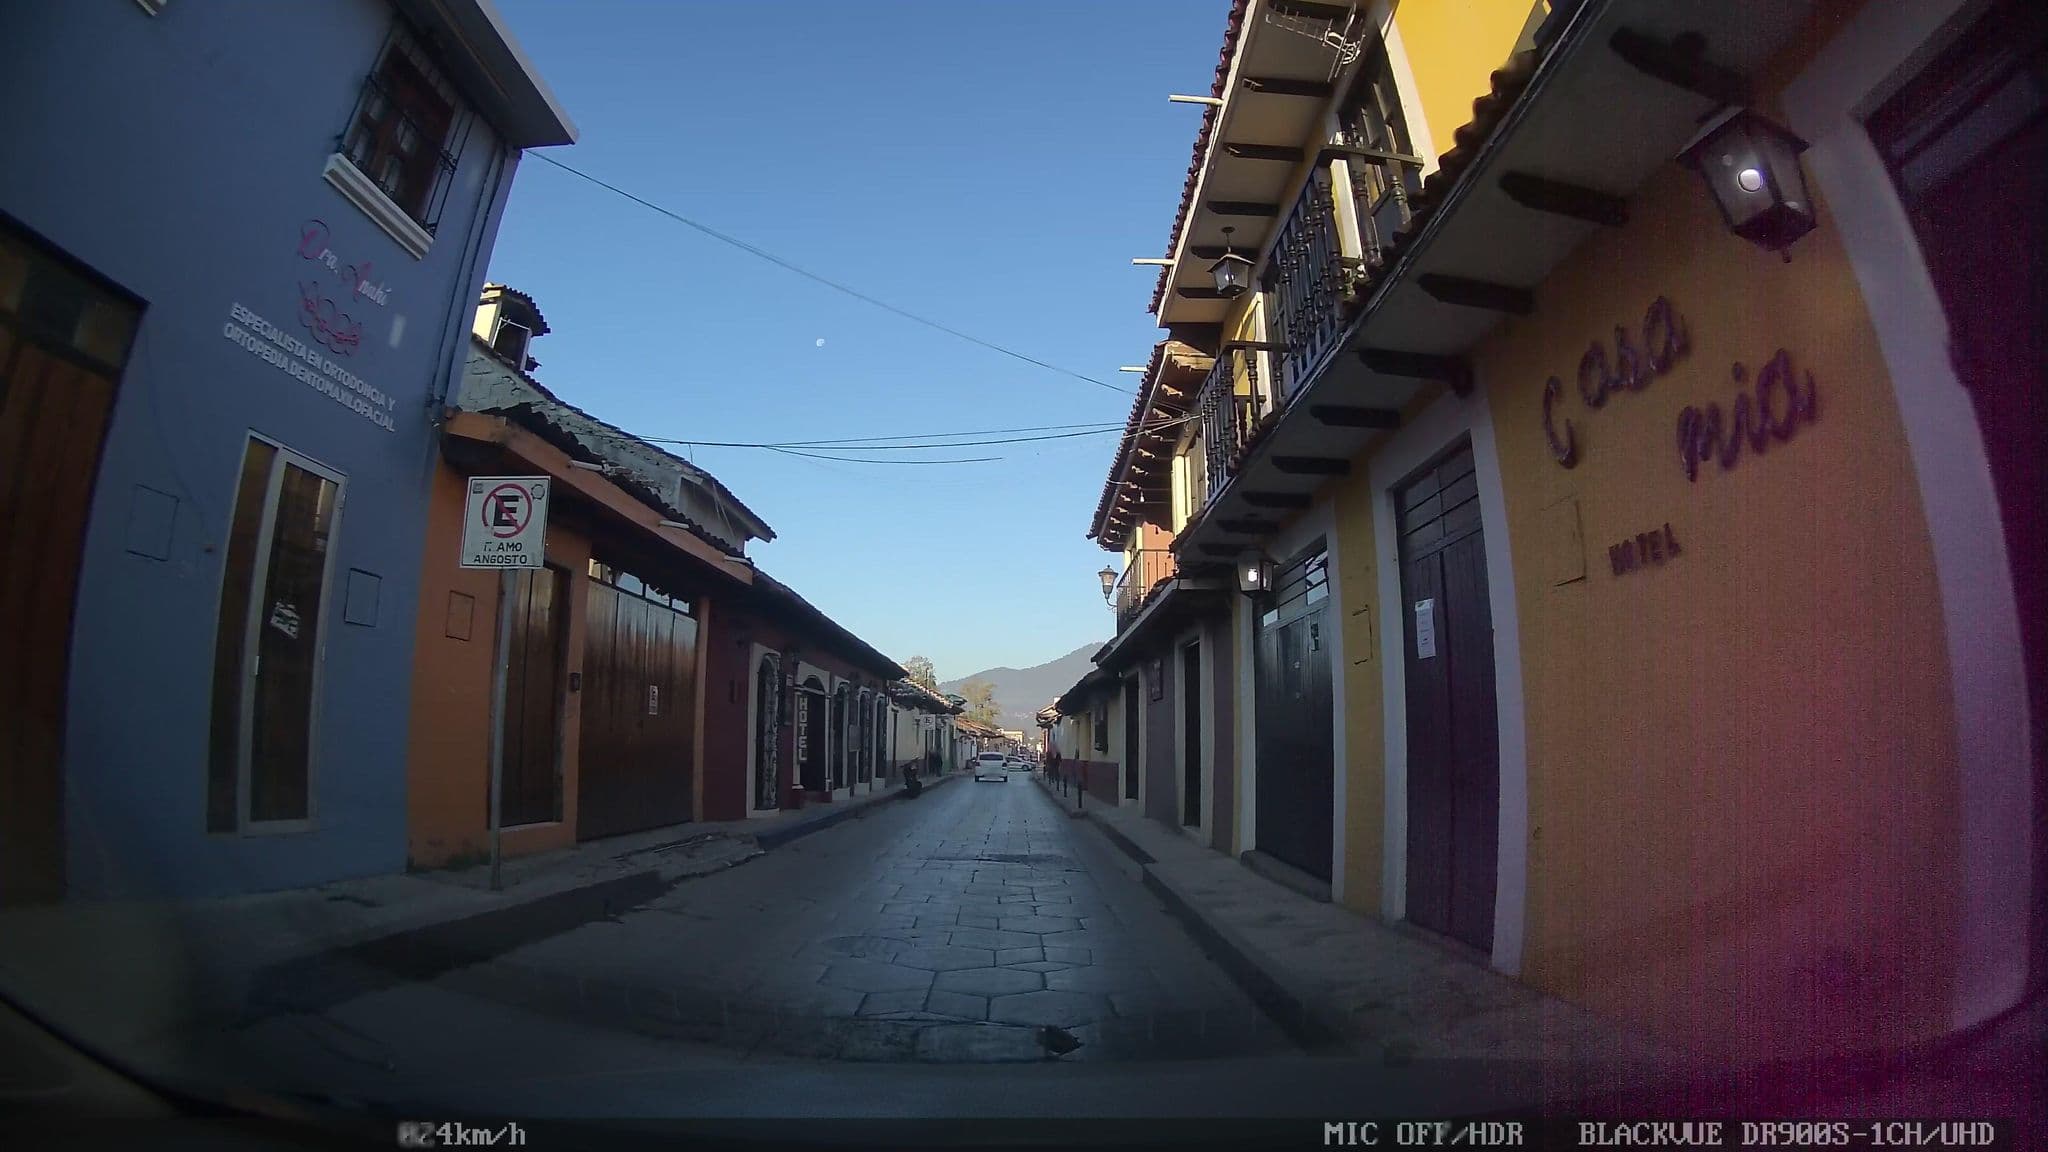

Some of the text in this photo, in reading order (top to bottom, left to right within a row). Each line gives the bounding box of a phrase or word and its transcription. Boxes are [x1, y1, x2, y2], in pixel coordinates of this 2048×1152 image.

[223, 322, 396, 432] ORTOPEDIA DENTOMAXILOFACIAL
[231, 302, 396, 411] ESPECIALISTA EN ORTODONCIA Y
[1543, 295, 1692, 470] Casa
[494, 495, 520, 526] E
[473, 554, 528, 564] ANGOSTO
[798, 696, 808, 761] HOTEL
